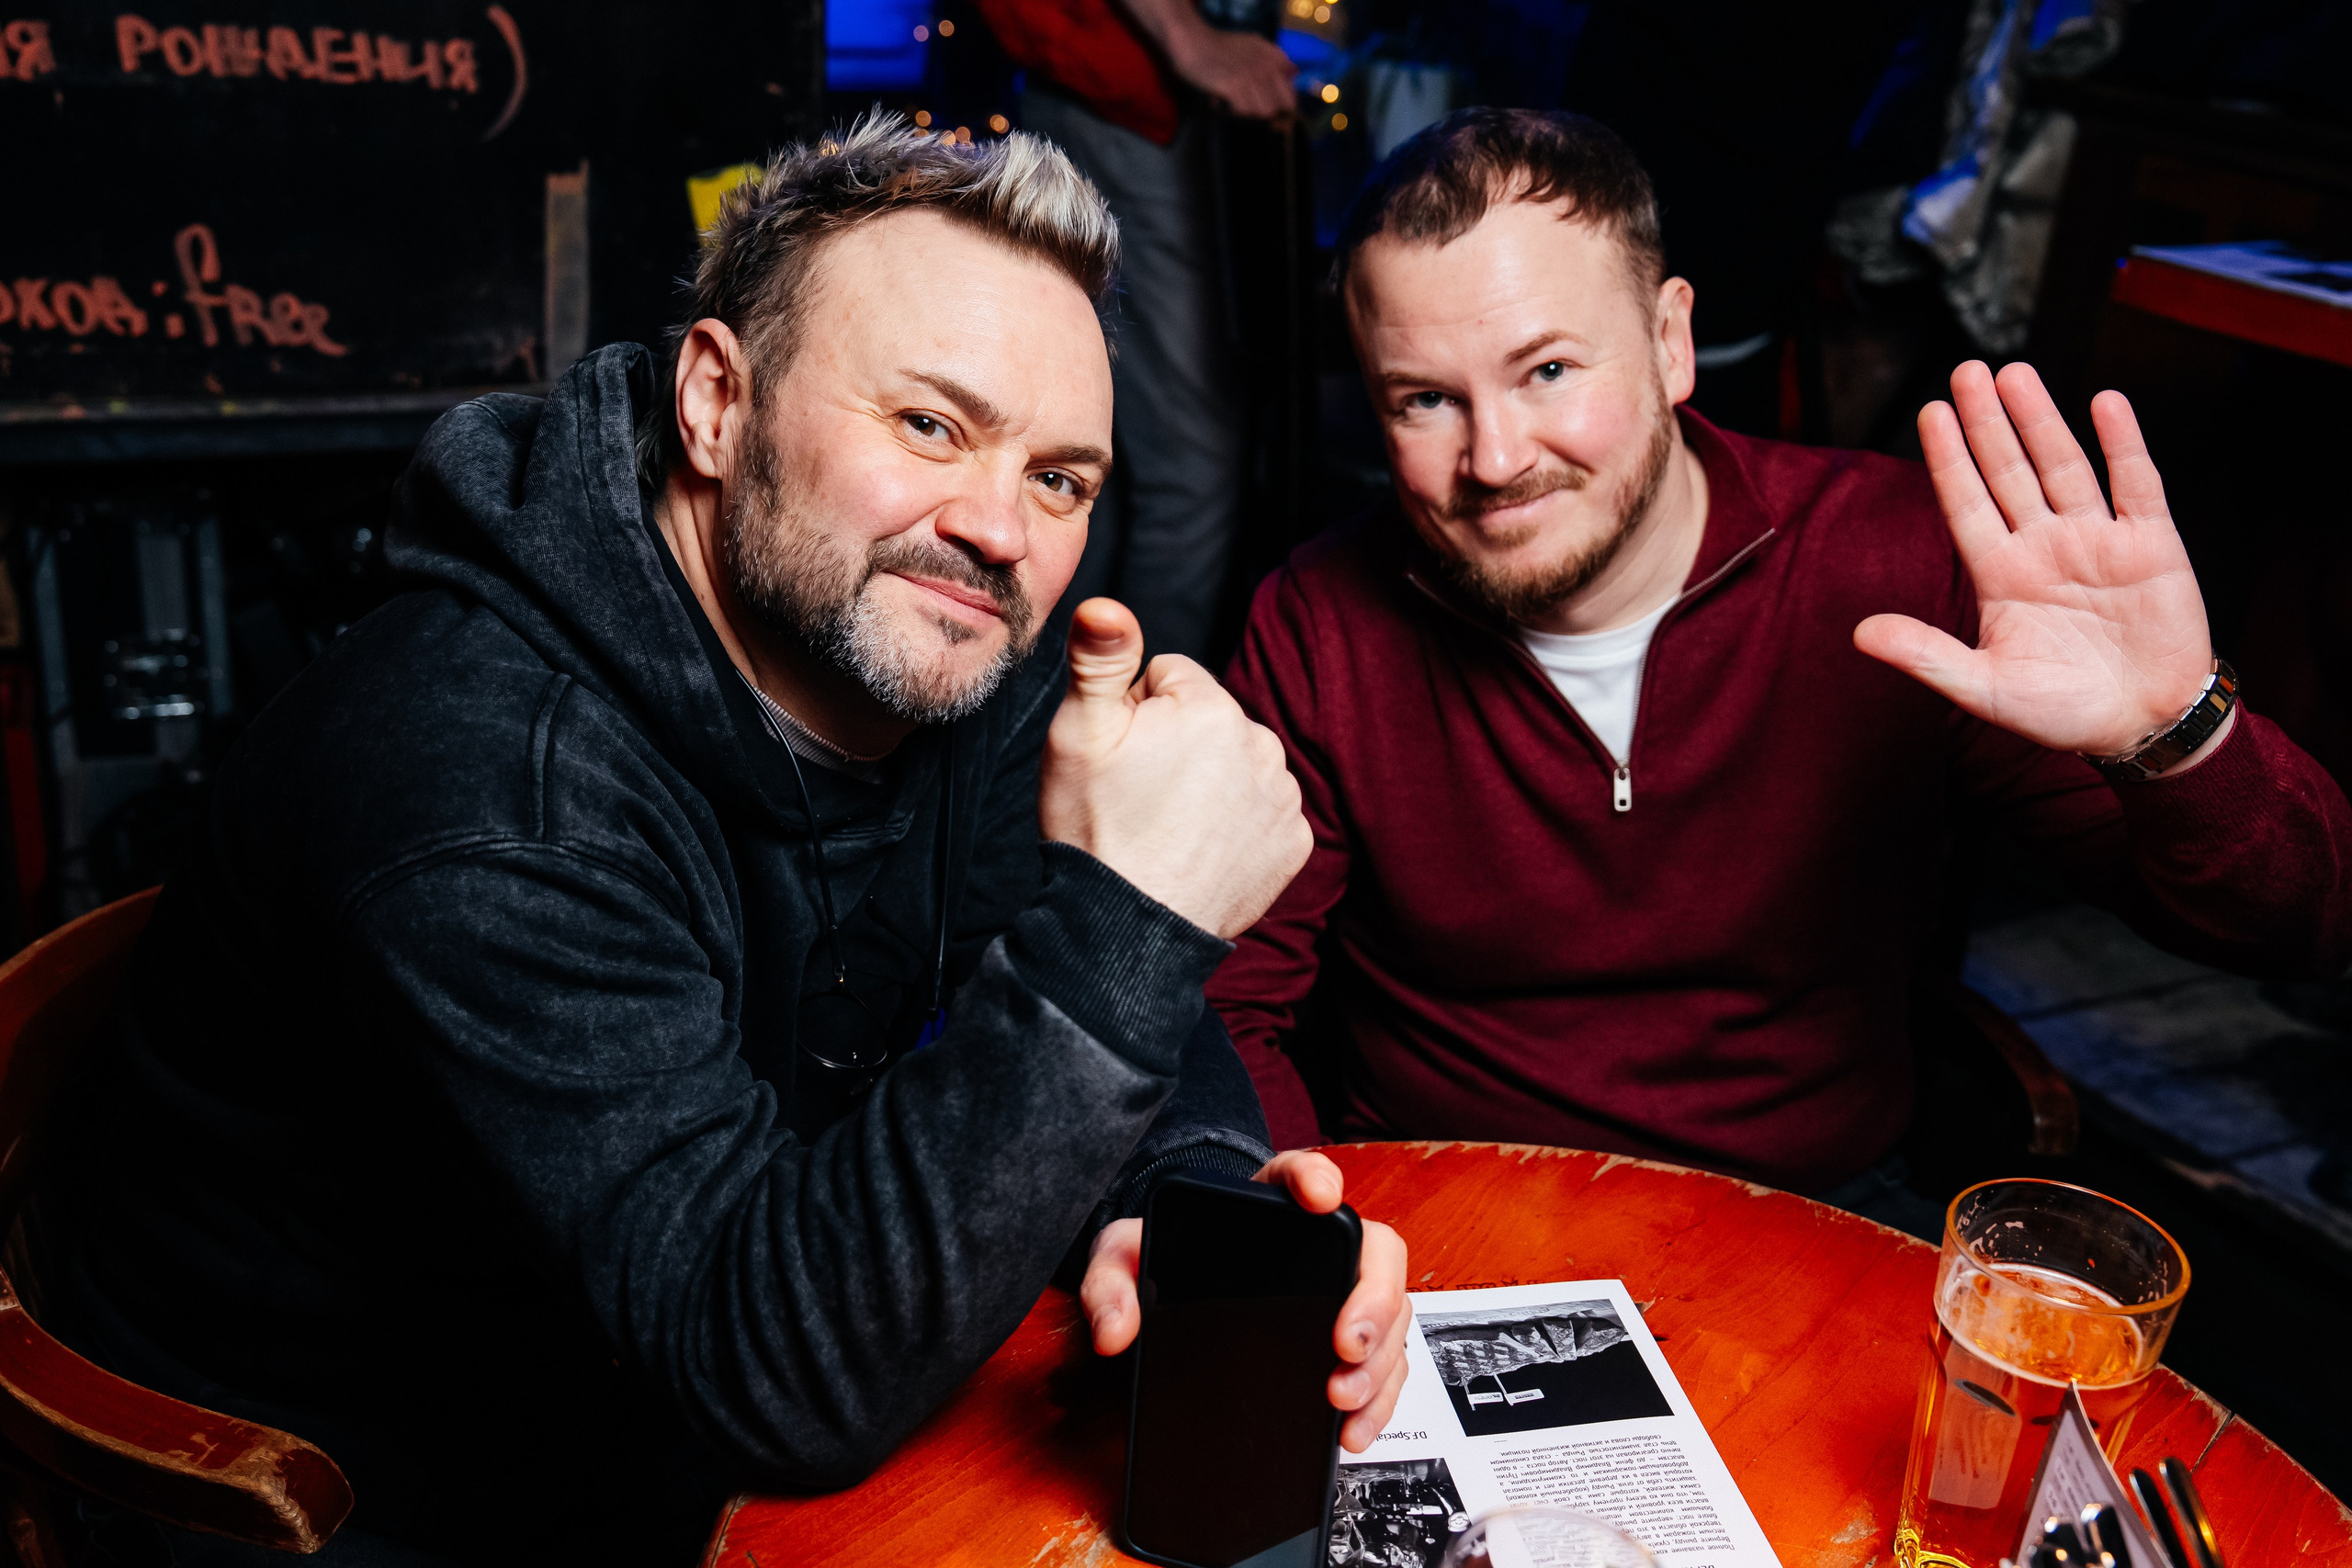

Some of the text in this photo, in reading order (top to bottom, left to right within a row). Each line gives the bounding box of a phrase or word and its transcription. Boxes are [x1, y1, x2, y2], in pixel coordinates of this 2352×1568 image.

[1532, 1444, 1571, 1454] жизненной
[1571, 1440, 1603, 1450] активной
[1587, 1443, 1641, 1453] знаменитостью.
[1615, 1449, 1659, 1458] среагировал
[1489, 1457, 1530, 1465] синонимом
[1575, 1461, 1611, 1470] Владимир
[1521, 1466, 1573, 1476] Владимирович
[1593, 1461, 1689, 1475] добровольцам-пожарникам
[1508, 1474, 1566, 1485] скоммуниздили,
[1557, 1479, 1586, 1487] десятки
[1589, 1475, 1618, 1483] деревне
[1540, 1486, 1590, 1497] (корабельный
[1610, 1488, 1640, 1496] которые
[1505, 1493, 1538, 1501] колокол)
[1593, 1497, 1623, 1506] прочему
[1596, 1505, 1626, 1513] обвинял
[1635, 1500, 1666, 1509] уровней
[1629, 1508, 1675, 1517] количеством
[1689, 1520, 1722, 1529] тверской
[1620, 1528, 1635, 1536] пер
